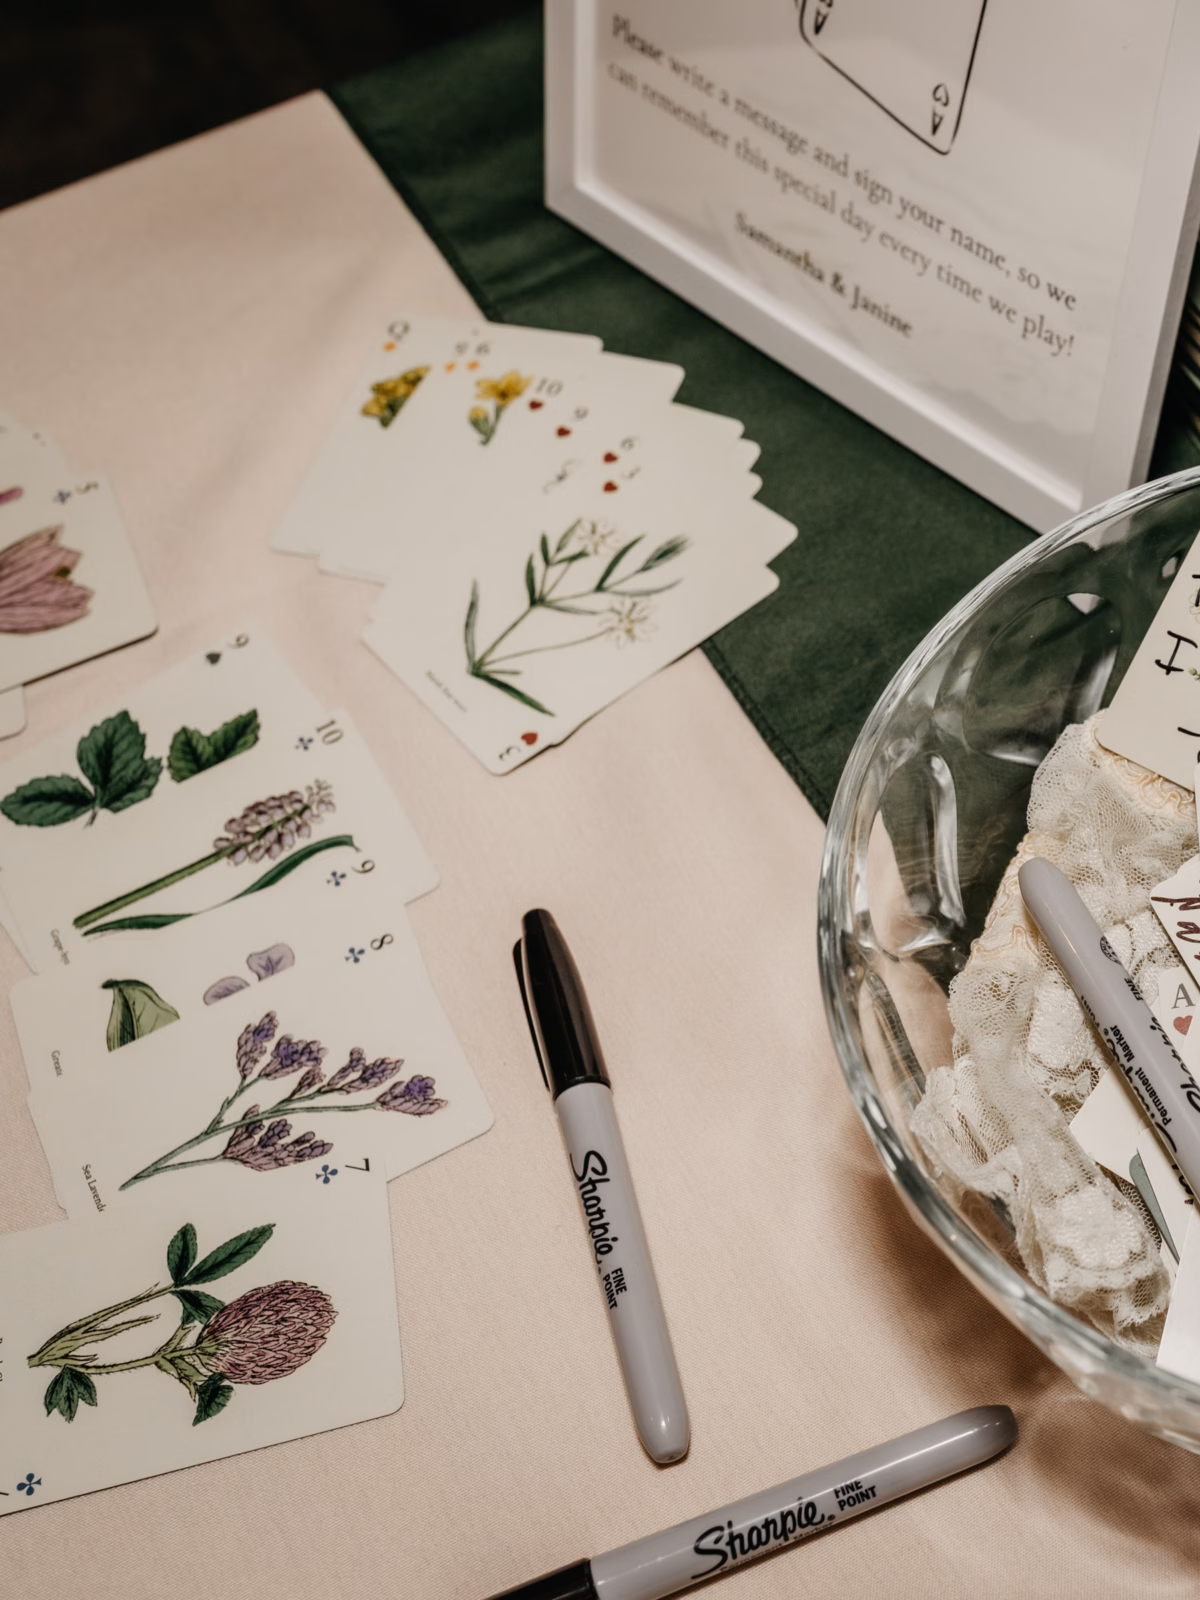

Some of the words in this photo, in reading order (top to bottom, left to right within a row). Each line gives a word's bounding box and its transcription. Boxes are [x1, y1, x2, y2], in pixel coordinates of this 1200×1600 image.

[612, 12, 664, 66] Please
[668, 55, 716, 98] write
[719, 88, 731, 107] a
[734, 97, 808, 156] message
[813, 143, 850, 179] and
[854, 168, 893, 207] sign
[897, 196, 946, 236] your
[950, 226, 1011, 279] name,
[1017, 264, 1041, 291] so
[1046, 282, 1077, 312] we
[607, 61, 639, 93] can
[641, 83, 730, 150] remember
[734, 136, 770, 175] this
[774, 164, 837, 217] special
[840, 201, 877, 244] day
[879, 231, 933, 278] every
[936, 261, 985, 304] time
[988, 294, 1018, 324] we
[1022, 314, 1076, 358] play!
[735, 210, 826, 284] Samantha
[829, 272, 848, 298] &
[850, 285, 914, 340] Janine
[1154, 630, 1199, 676] I
[314, 718, 344, 746] 10
[369, 932, 394, 952] 8
[1170, 981, 1197, 1010] A
[1109, 1024, 1136, 1064] Marker
[1134, 1065, 1173, 1127] Permanent
[81, 1163, 93, 1181] Sea
[344, 1157, 371, 1173] 7
[569, 1149, 620, 1265] Sharpie
[602, 1272, 619, 1311] POINT
[610, 1266, 628, 1297] FINE
[833, 1479, 864, 1500] FINE
[836, 1485, 878, 1512] POINT
[691, 1496, 826, 1581] Sharpie
